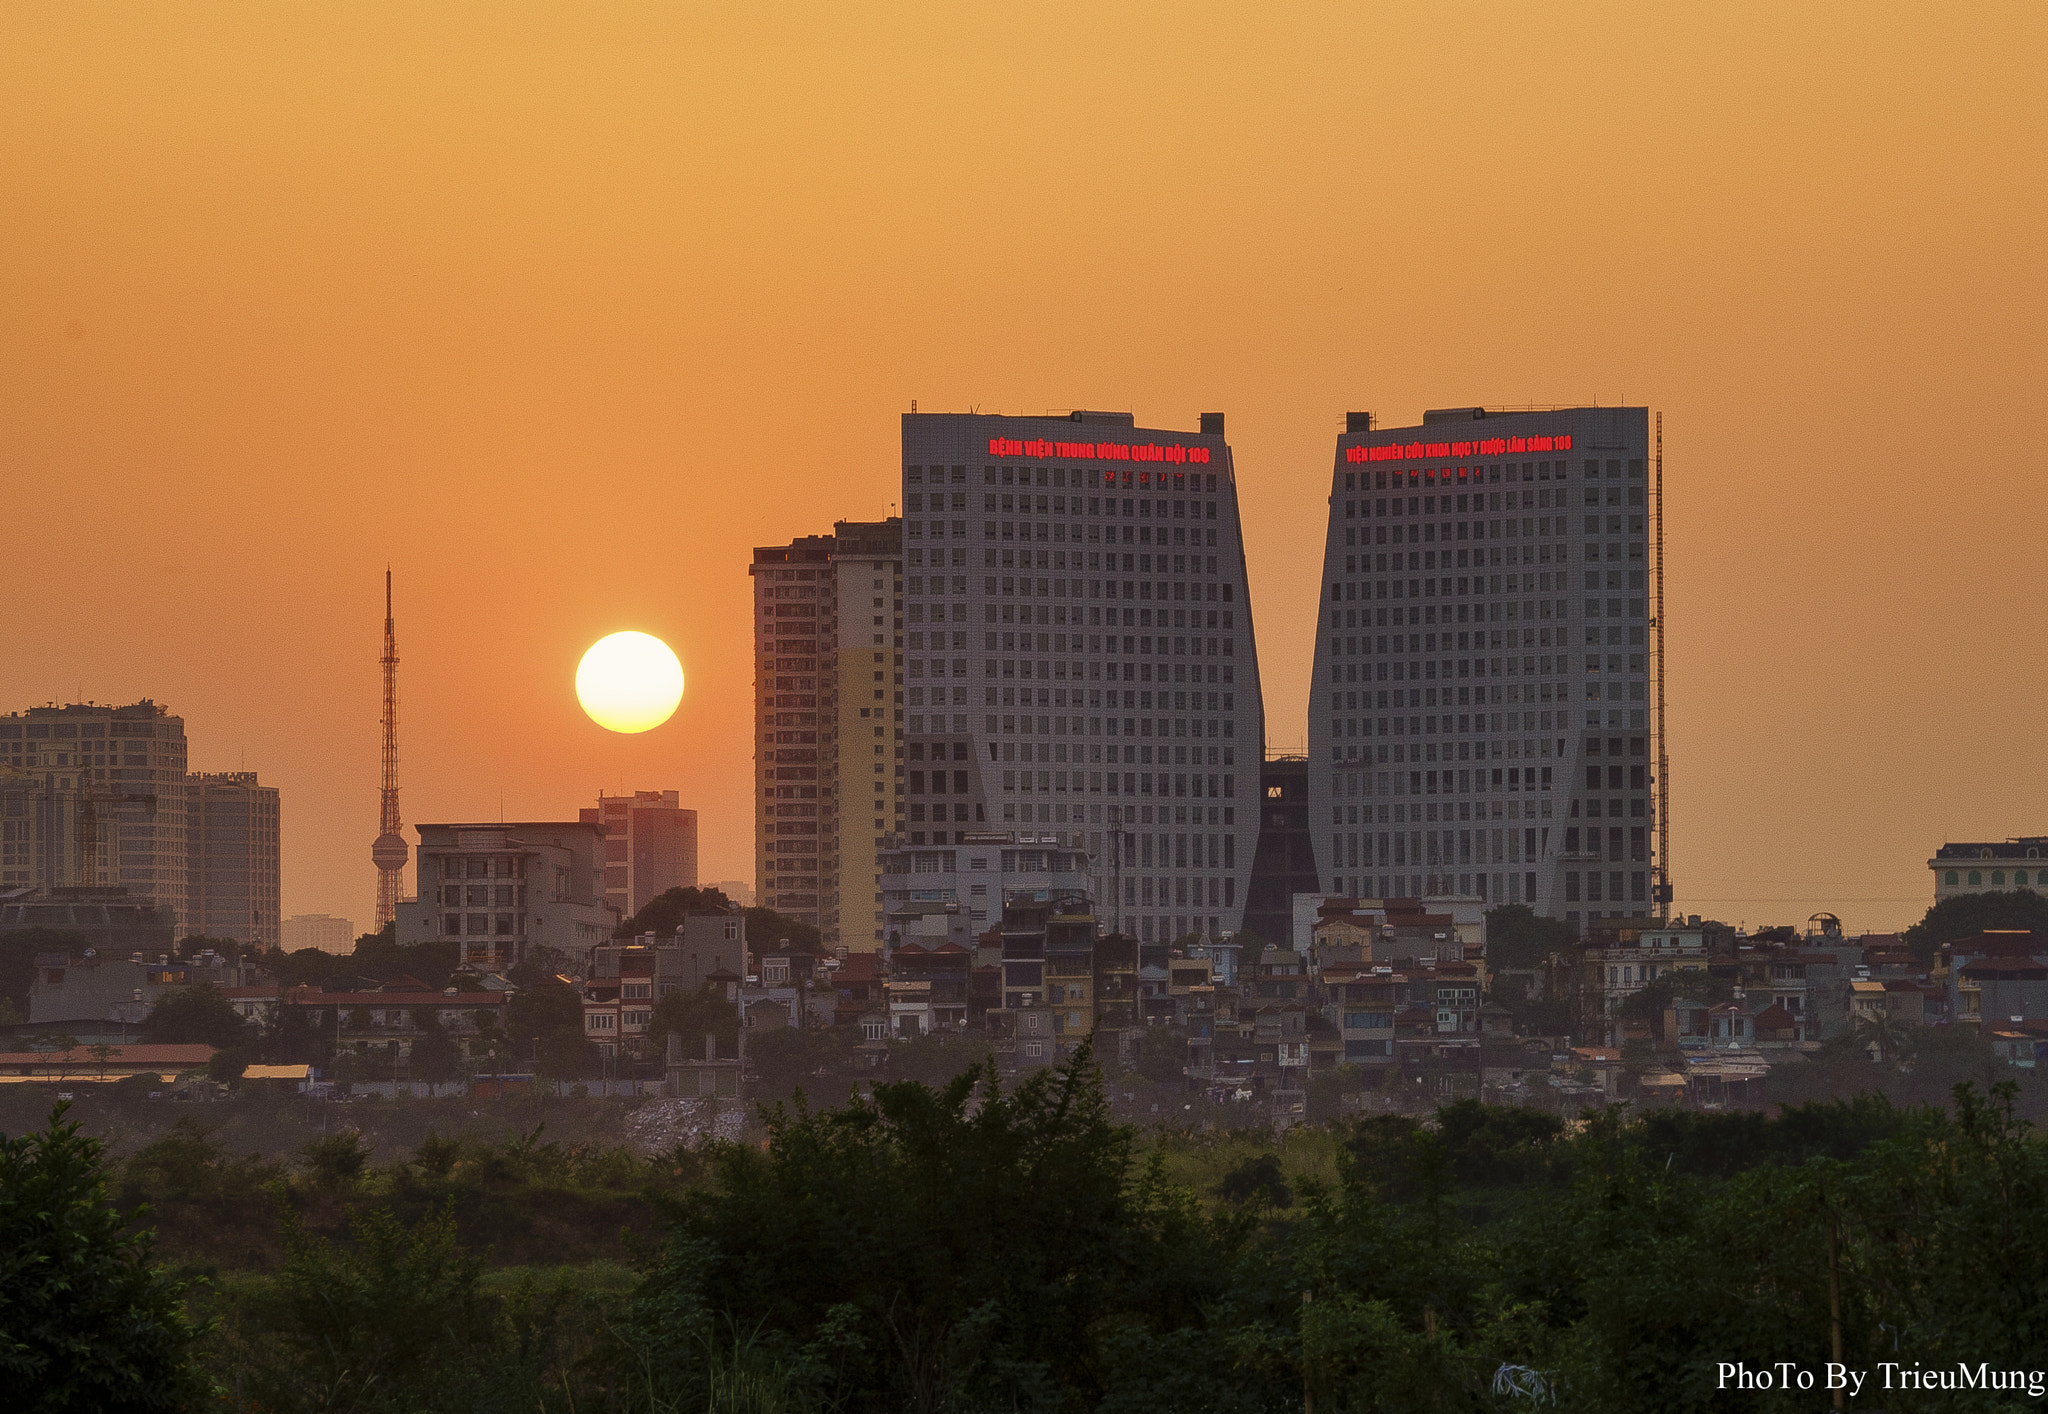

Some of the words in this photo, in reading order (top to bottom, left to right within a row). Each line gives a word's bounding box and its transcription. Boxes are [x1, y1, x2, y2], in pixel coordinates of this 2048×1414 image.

[989, 437, 1022, 457] BỆNH
[1024, 438, 1053, 459] VIỆN
[1055, 442, 1095, 458] TRUNG
[1131, 443, 1163, 462] QUÂN
[1187, 447, 1209, 463] 108
[1346, 445, 1368, 464] VIỆN
[1425, 443, 1450, 457] KHOA
[1452, 442, 1471, 458] HỌC
[1472, 441, 1479, 455] Y
[1507, 436, 1526, 453] LÂM
[1553, 435, 1571, 450] 108
